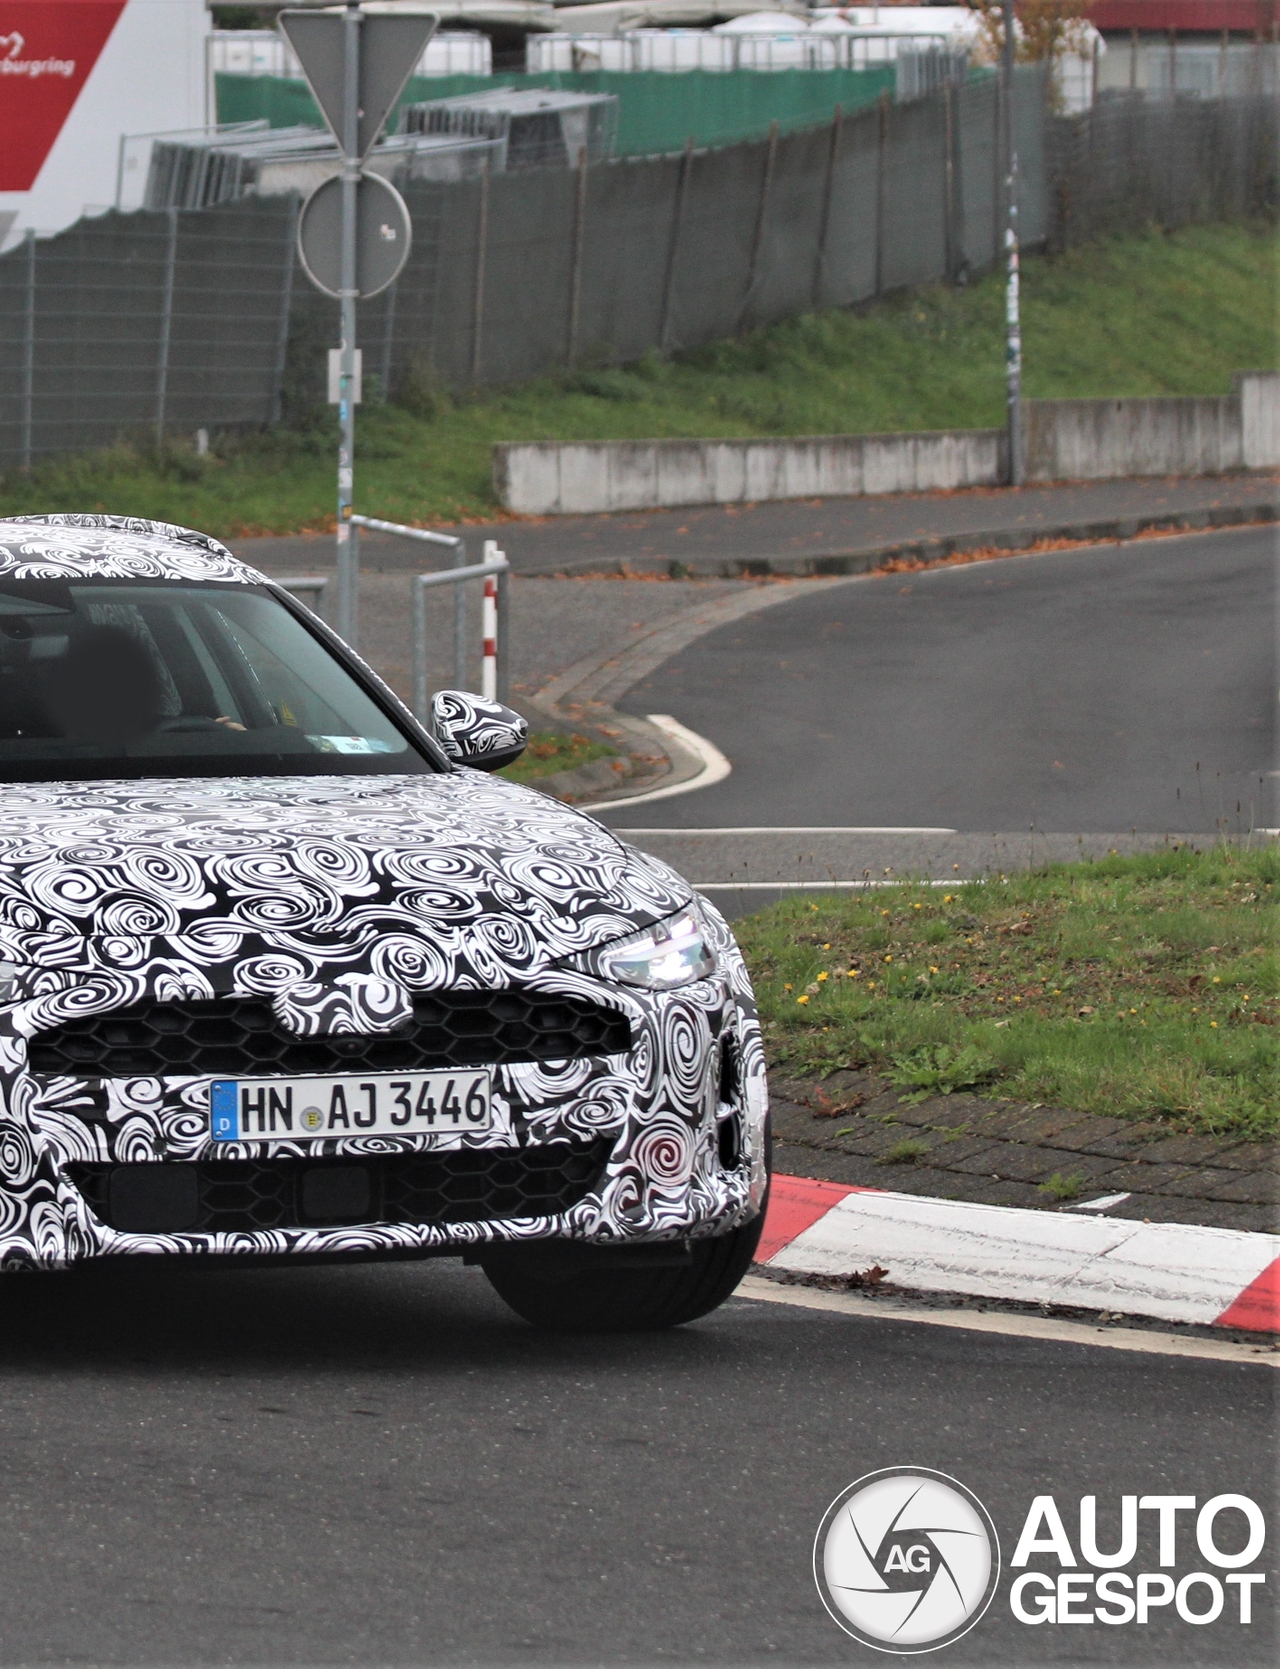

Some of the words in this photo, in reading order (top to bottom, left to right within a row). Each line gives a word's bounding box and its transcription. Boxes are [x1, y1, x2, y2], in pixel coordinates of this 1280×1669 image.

[241, 1086, 293, 1132] HN
[328, 1083, 376, 1129] AJ
[390, 1078, 486, 1126] 3446
[220, 1118, 230, 1131] D
